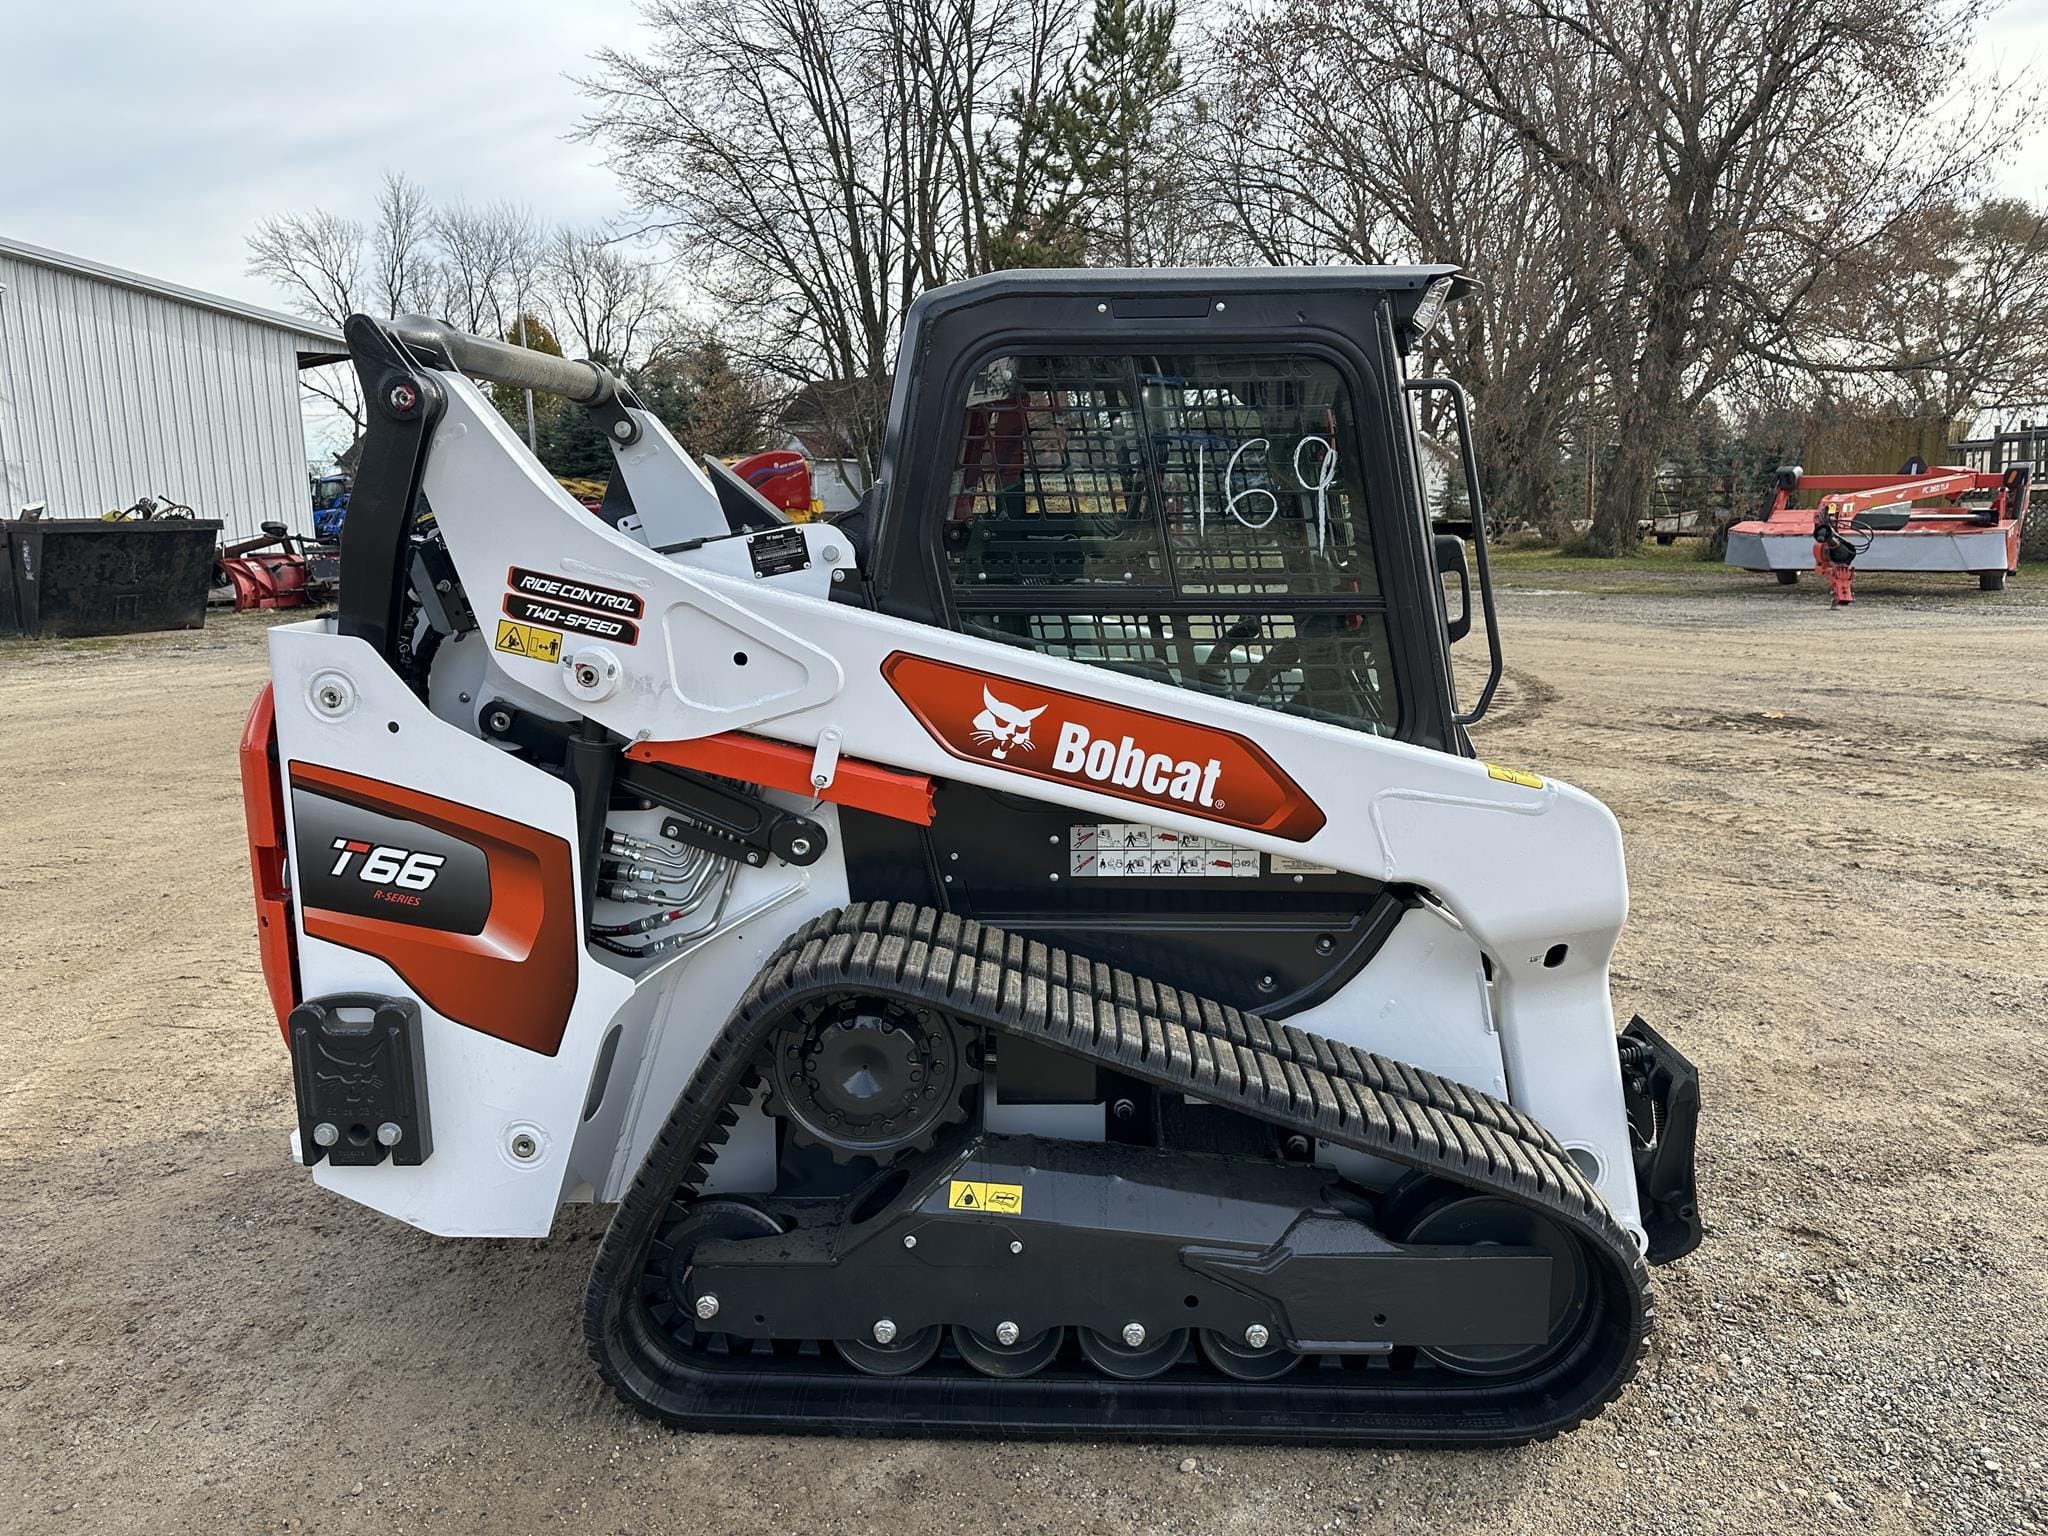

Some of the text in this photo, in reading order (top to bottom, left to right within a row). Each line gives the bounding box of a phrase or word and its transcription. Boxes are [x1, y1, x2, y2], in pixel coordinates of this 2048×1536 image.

[1198, 436, 1338, 558] 169
[520, 575, 635, 612] RIDE CONTROL
[525, 604, 622, 636] TWO-SPEED
[1051, 720, 1222, 808] Bobcat
[331, 838, 446, 891] T66
[373, 889, 422, 907] R-SERIES
